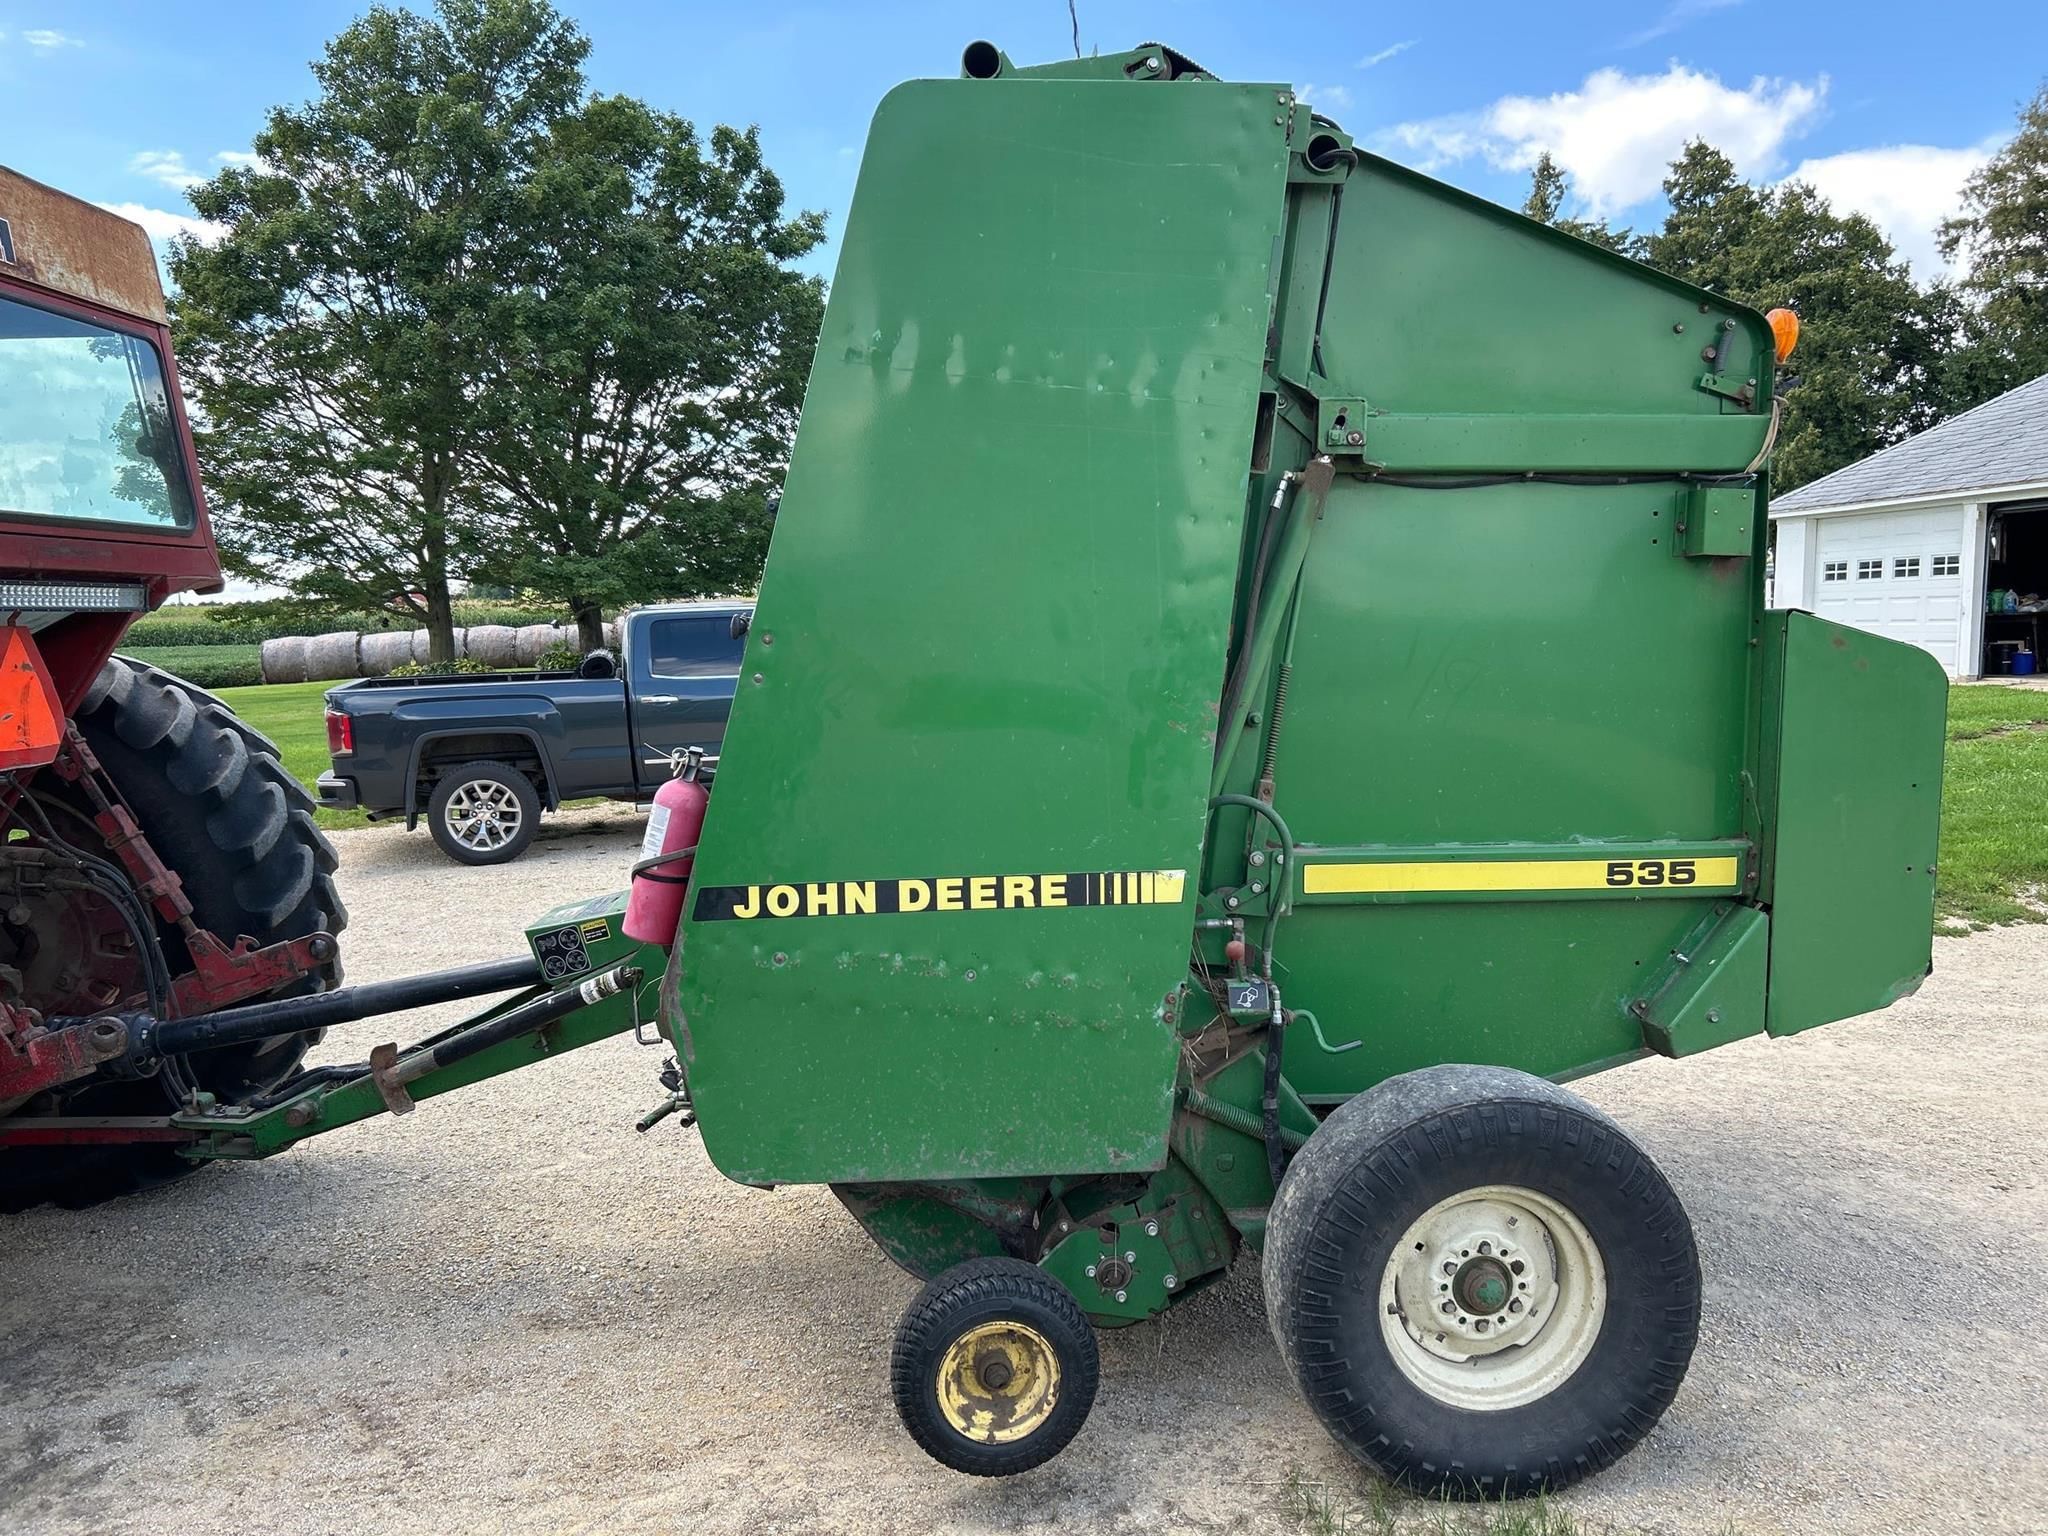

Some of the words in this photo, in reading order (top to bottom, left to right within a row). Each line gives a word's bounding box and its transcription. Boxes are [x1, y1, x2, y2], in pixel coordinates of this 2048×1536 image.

[1606, 861, 1696, 886] 535
[733, 881, 876, 918] JOHN
[898, 874, 1068, 914] DEERE
